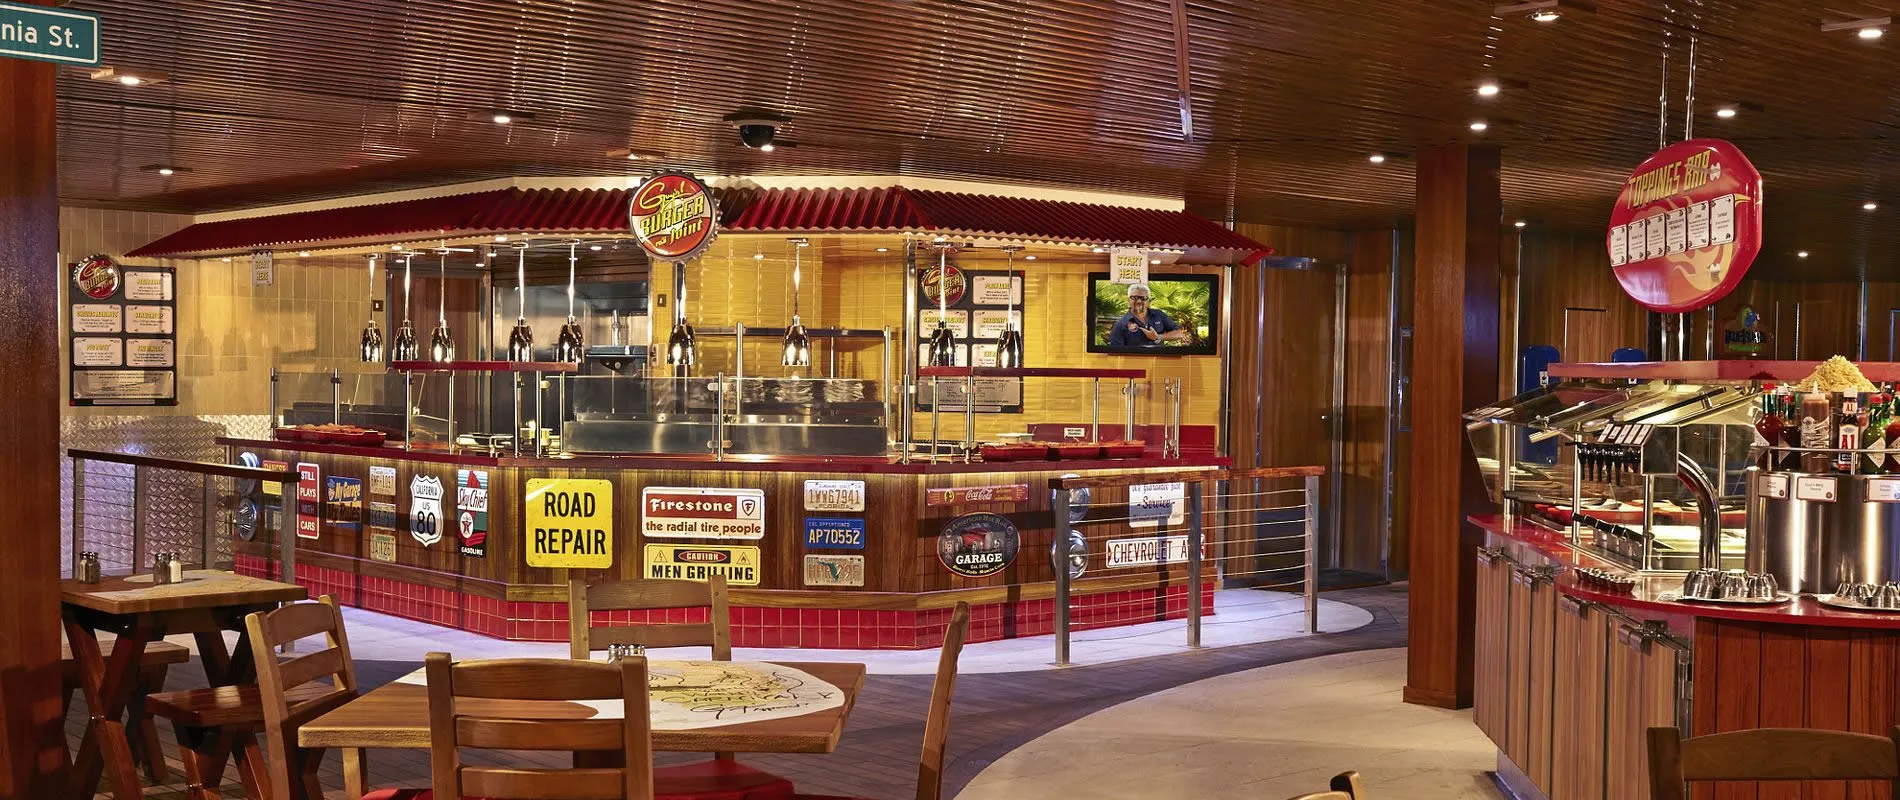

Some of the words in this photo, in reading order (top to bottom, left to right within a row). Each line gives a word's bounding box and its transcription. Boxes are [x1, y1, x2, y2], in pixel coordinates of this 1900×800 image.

[2, 20, 38, 44] nia
[49, 25, 80, 49] St.
[1628, 161, 1682, 210] TOPPINGS
[1683, 150, 1712, 192] BAR
[640, 194, 705, 237] BURGER
[669, 218, 703, 245] Joint
[1117, 255, 1143, 267] START
[1119, 269, 1141, 280] HERE
[301, 471, 315, 481] STILL
[300, 487, 316, 498] PLAYS
[415, 484, 438, 496] CALIFORNIA
[301, 503, 315, 514] WITH
[422, 502, 431, 511] US
[544, 491, 596, 518] ROAD
[649, 498, 733, 513] Firestone
[300, 521, 316, 532] CARS
[416, 510, 437, 536] 80
[646, 521, 663, 531] the
[666, 522, 697, 532] radial
[701, 522, 719, 533] tire
[722, 523, 761, 535] people
[535, 528, 606, 555] REPAIR
[808, 529, 861, 545] AP70552
[461, 546, 483, 556] GASOLINE
[686, 552, 719, 561] CAUTION
[1113, 540, 1173, 564] CHEVROLET
[955, 553, 1003, 565] GARAGE
[652, 565, 681, 578] MEN
